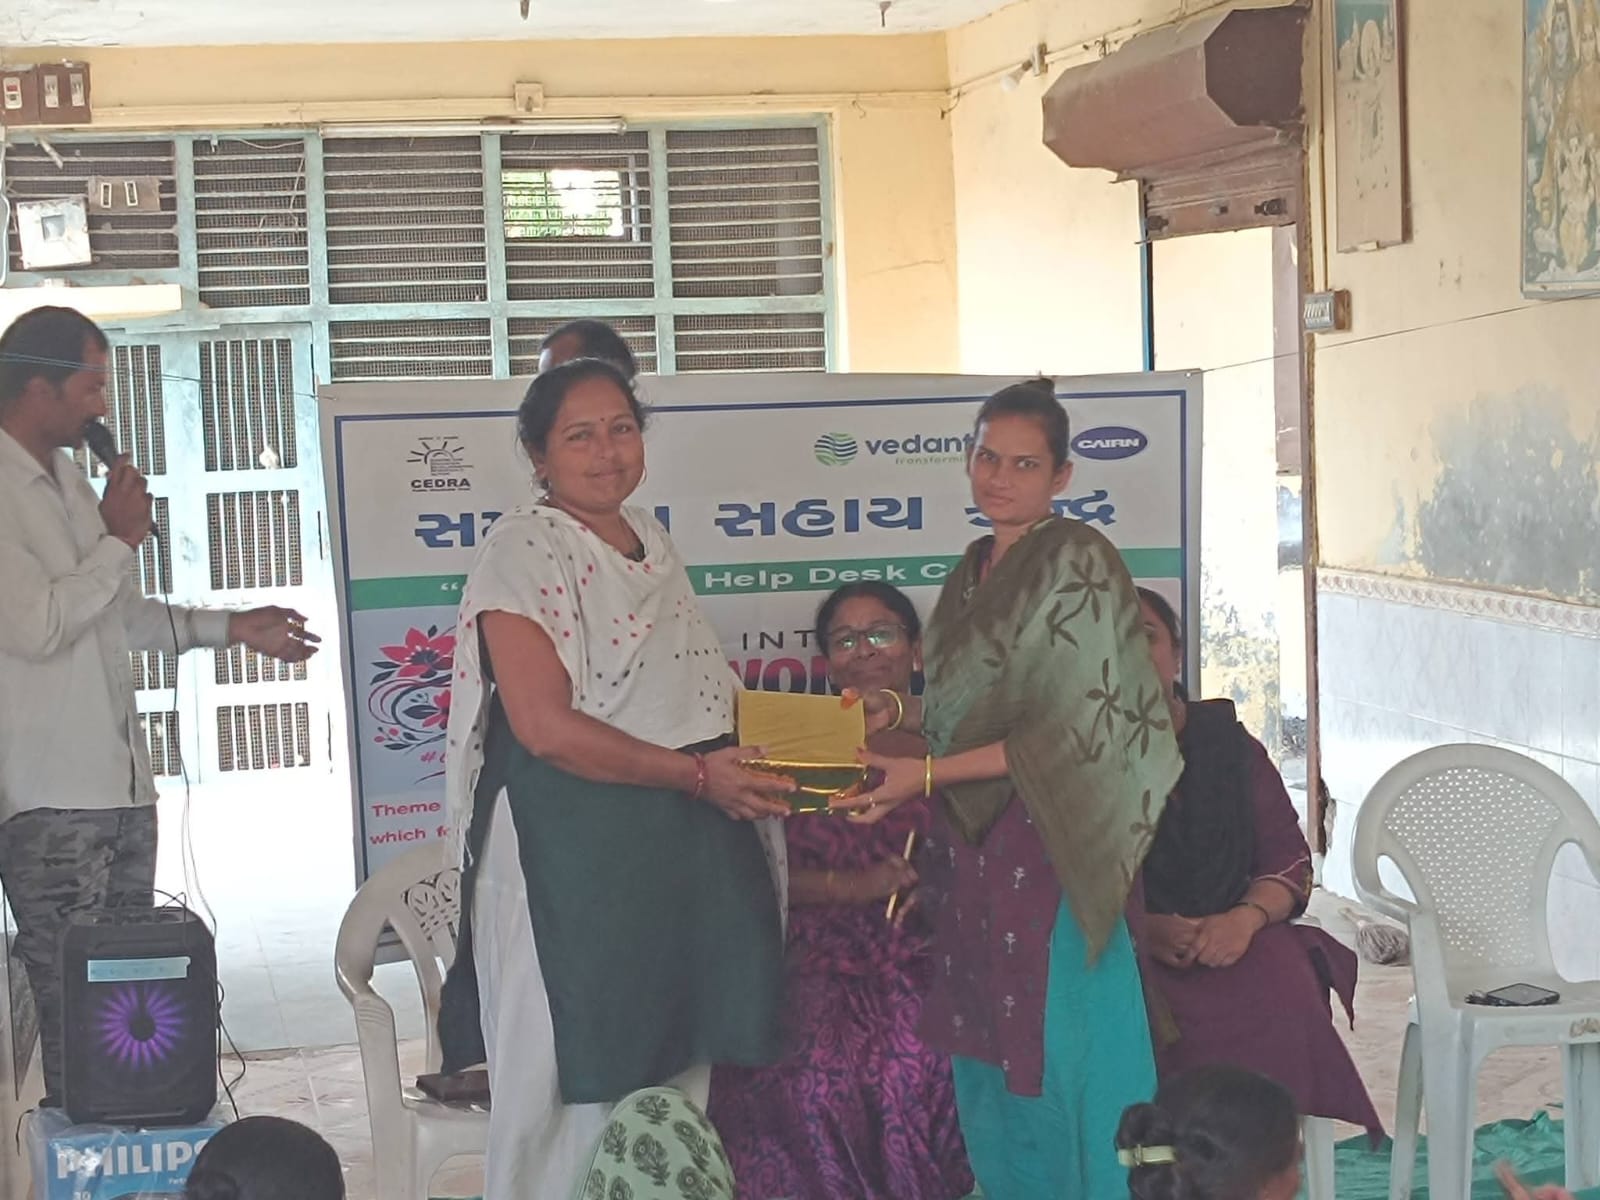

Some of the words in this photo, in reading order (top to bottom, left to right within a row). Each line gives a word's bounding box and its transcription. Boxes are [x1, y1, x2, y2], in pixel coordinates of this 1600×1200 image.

[865, 434, 976, 455] vedant
[1077, 438, 1140, 450] CAIRN
[895, 455, 967, 465] transformi
[410, 478, 471, 489] CEDRA
[714, 496, 924, 538] સહાય
[704, 569, 794, 589] Help
[808, 565, 907, 584] Desk
[371, 802, 441, 818] Theme
[369, 828, 427, 845] which
